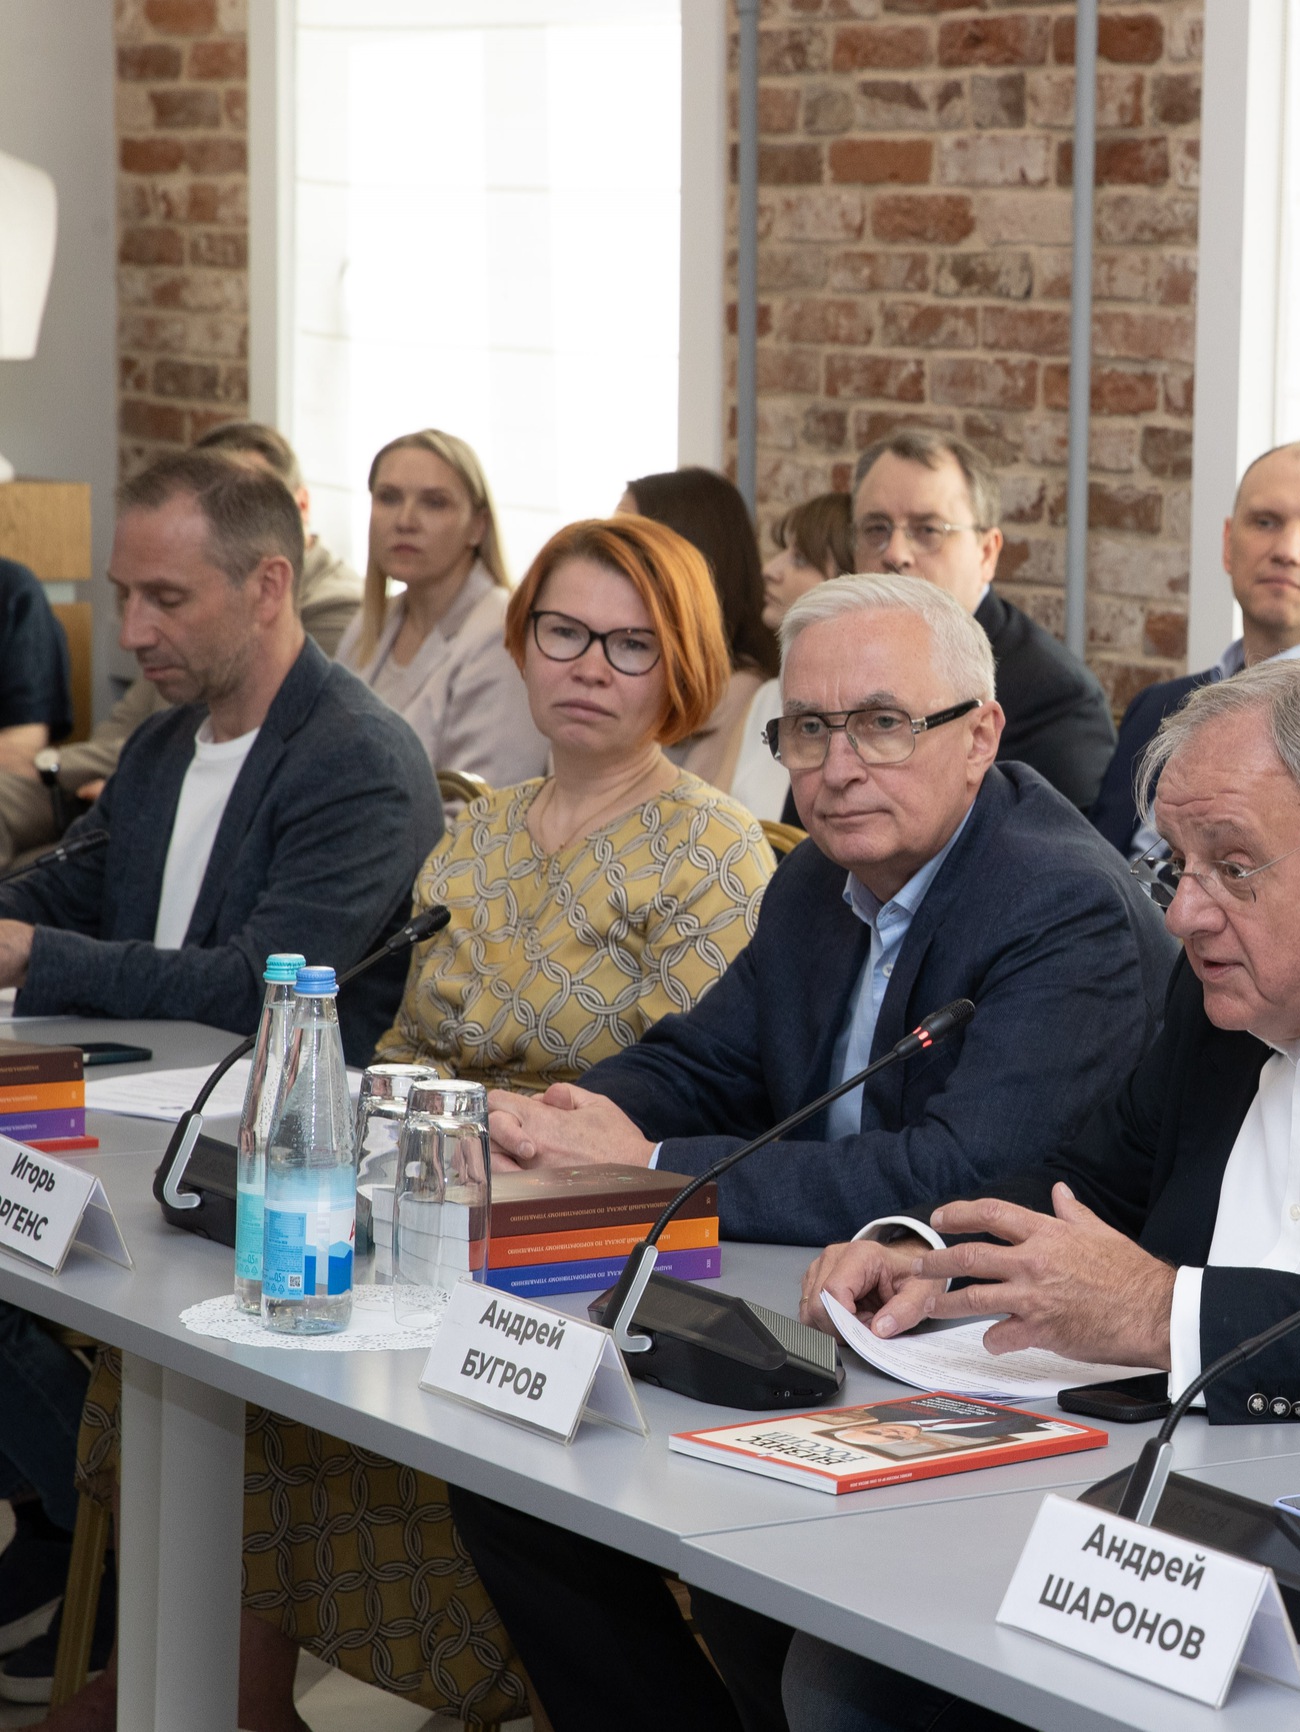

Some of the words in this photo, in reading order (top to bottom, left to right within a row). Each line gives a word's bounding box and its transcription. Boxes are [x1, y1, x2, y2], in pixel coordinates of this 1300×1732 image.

[10, 1152, 56, 1193] Игорь
[0, 1194, 49, 1241] РГЕНС
[510, 1213, 547, 1222] УПРАВЛЕНИЮ
[507, 1246, 544, 1255] УПРАВЛЕНИЮ
[510, 1278, 547, 1287] УПРАВЛЕНИЮ
[478, 1300, 567, 1350] Андрей
[460, 1348, 547, 1401] БУГРОВ
[735, 1435, 847, 1466] БИЗНЕС
[760, 1431, 868, 1462] РОССИИ
[1081, 1523, 1206, 1591] Андрей
[1038, 1573, 1206, 1660] ШАРОНОВ
